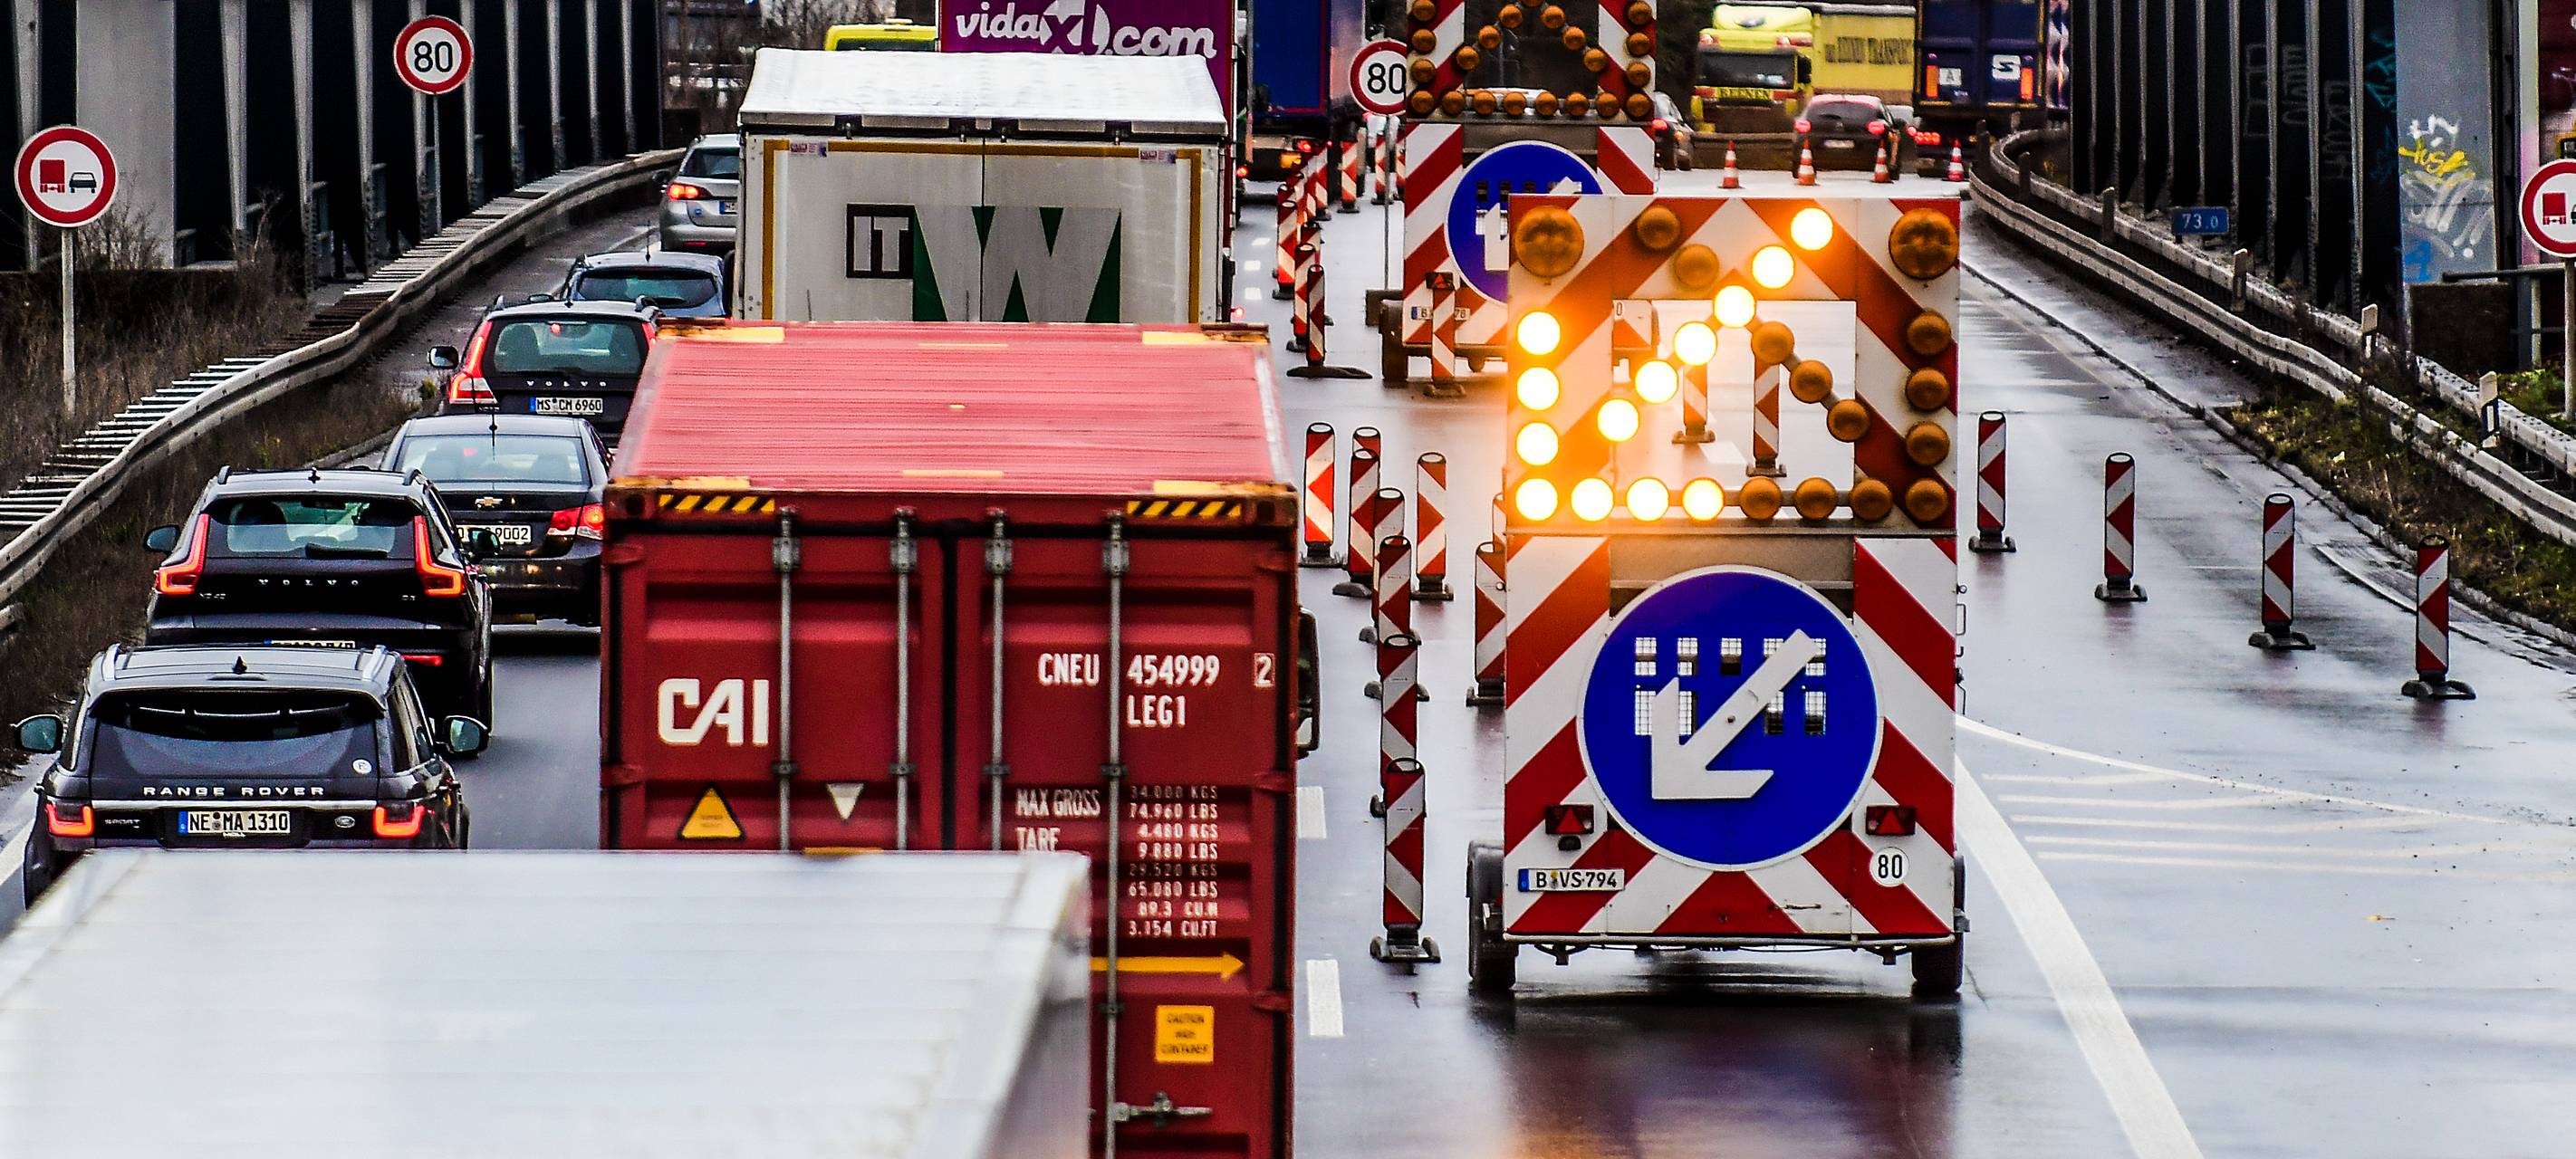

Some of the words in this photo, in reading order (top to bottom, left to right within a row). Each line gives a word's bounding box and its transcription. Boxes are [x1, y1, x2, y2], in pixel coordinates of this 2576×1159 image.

[414, 41, 453, 72] 80
[1368, 62, 1407, 94] 80
[2182, 213, 2219, 229] 73.0
[536, 399, 551, 411] MS
[558, 399, 572, 411] CM
[575, 399, 602, 411] 6960
[1038, 653, 1101, 686] CNEU
[1127, 654, 1221, 687] 454999
[1255, 655, 1274, 687] 2
[658, 678, 770, 747] CAI
[1127, 694, 1187, 727] LEG1
[143, 786, 226, 797] RANGE
[241, 786, 324, 797] ROVER
[1190, 785, 1217, 800] KGS
[1015, 788, 1049, 817] MAX
[1053, 789, 1101, 817] GROSS
[1189, 803, 1218, 819] LBS
[189, 813, 211, 831] NE
[223, 813, 244, 831] MA
[248, 813, 289, 831] 1310
[1189, 823, 1218, 838] KGS
[1189, 843, 1218, 859] LBS
[1878, 854, 1903, 879] 80
[1535, 871, 1547, 888] B
[1189, 881, 1218, 898] LBS
[1138, 901, 1172, 917] 89.3
[1129, 920, 1172, 936] 3.154
